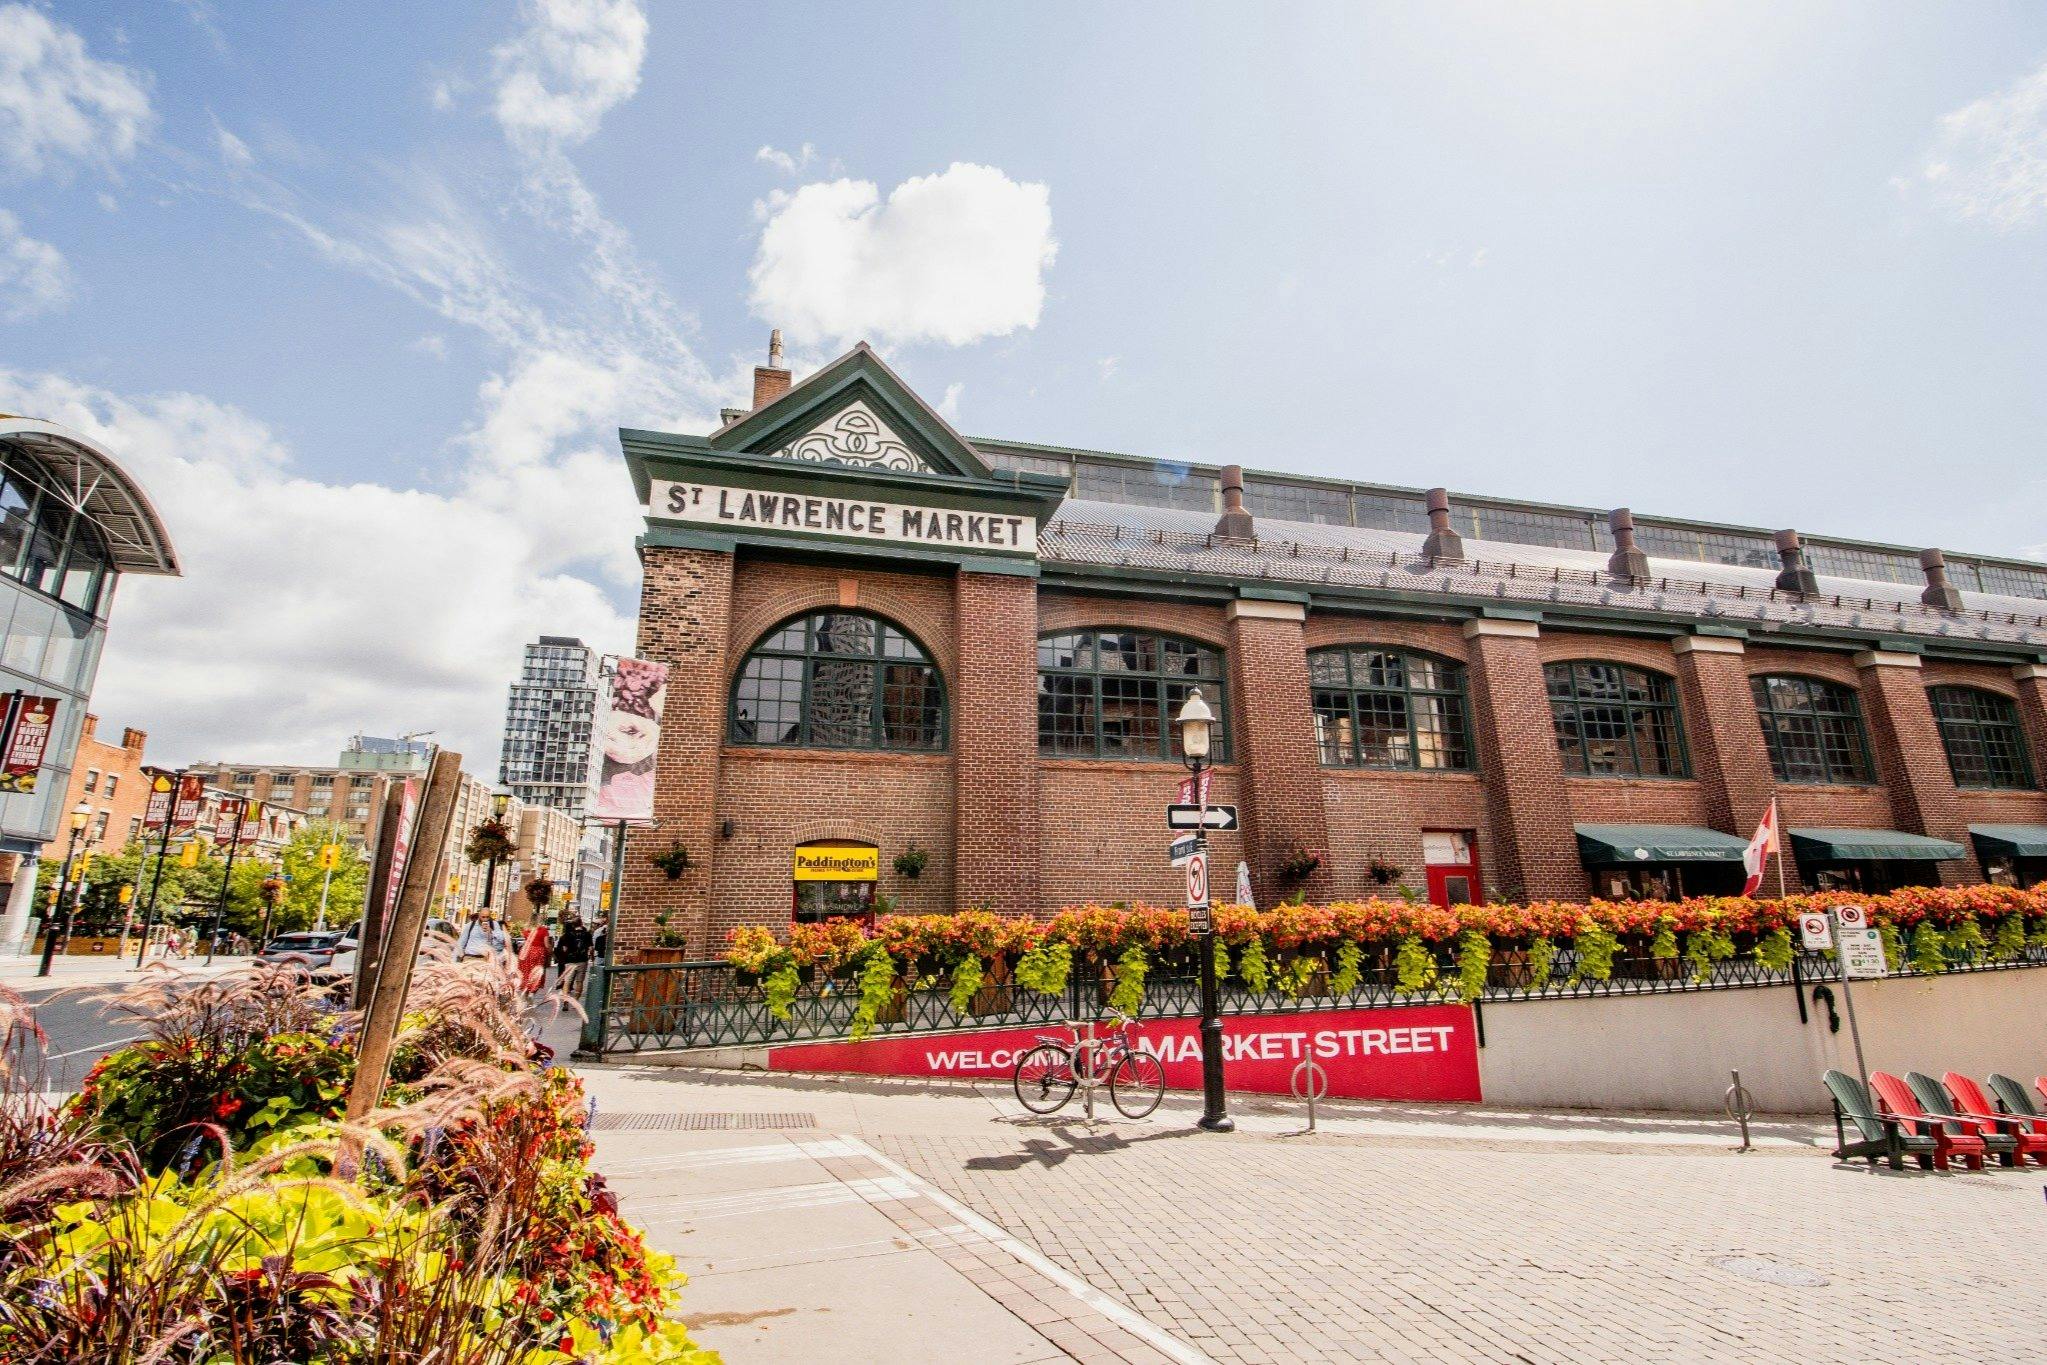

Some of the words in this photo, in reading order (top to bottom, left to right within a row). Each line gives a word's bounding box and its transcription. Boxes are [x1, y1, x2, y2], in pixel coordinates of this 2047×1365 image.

[719, 490, 886, 533] LAWRENCE
[902, 509, 1022, 545] MARKET
[15, 734, 46, 747] OPEN
[797, 855, 876, 872] Paddington's
[926, 1048, 1074, 1070] WELCOME
[1138, 1033, 1306, 1063] MARKET
[1315, 1027, 1454, 1058] STREET
